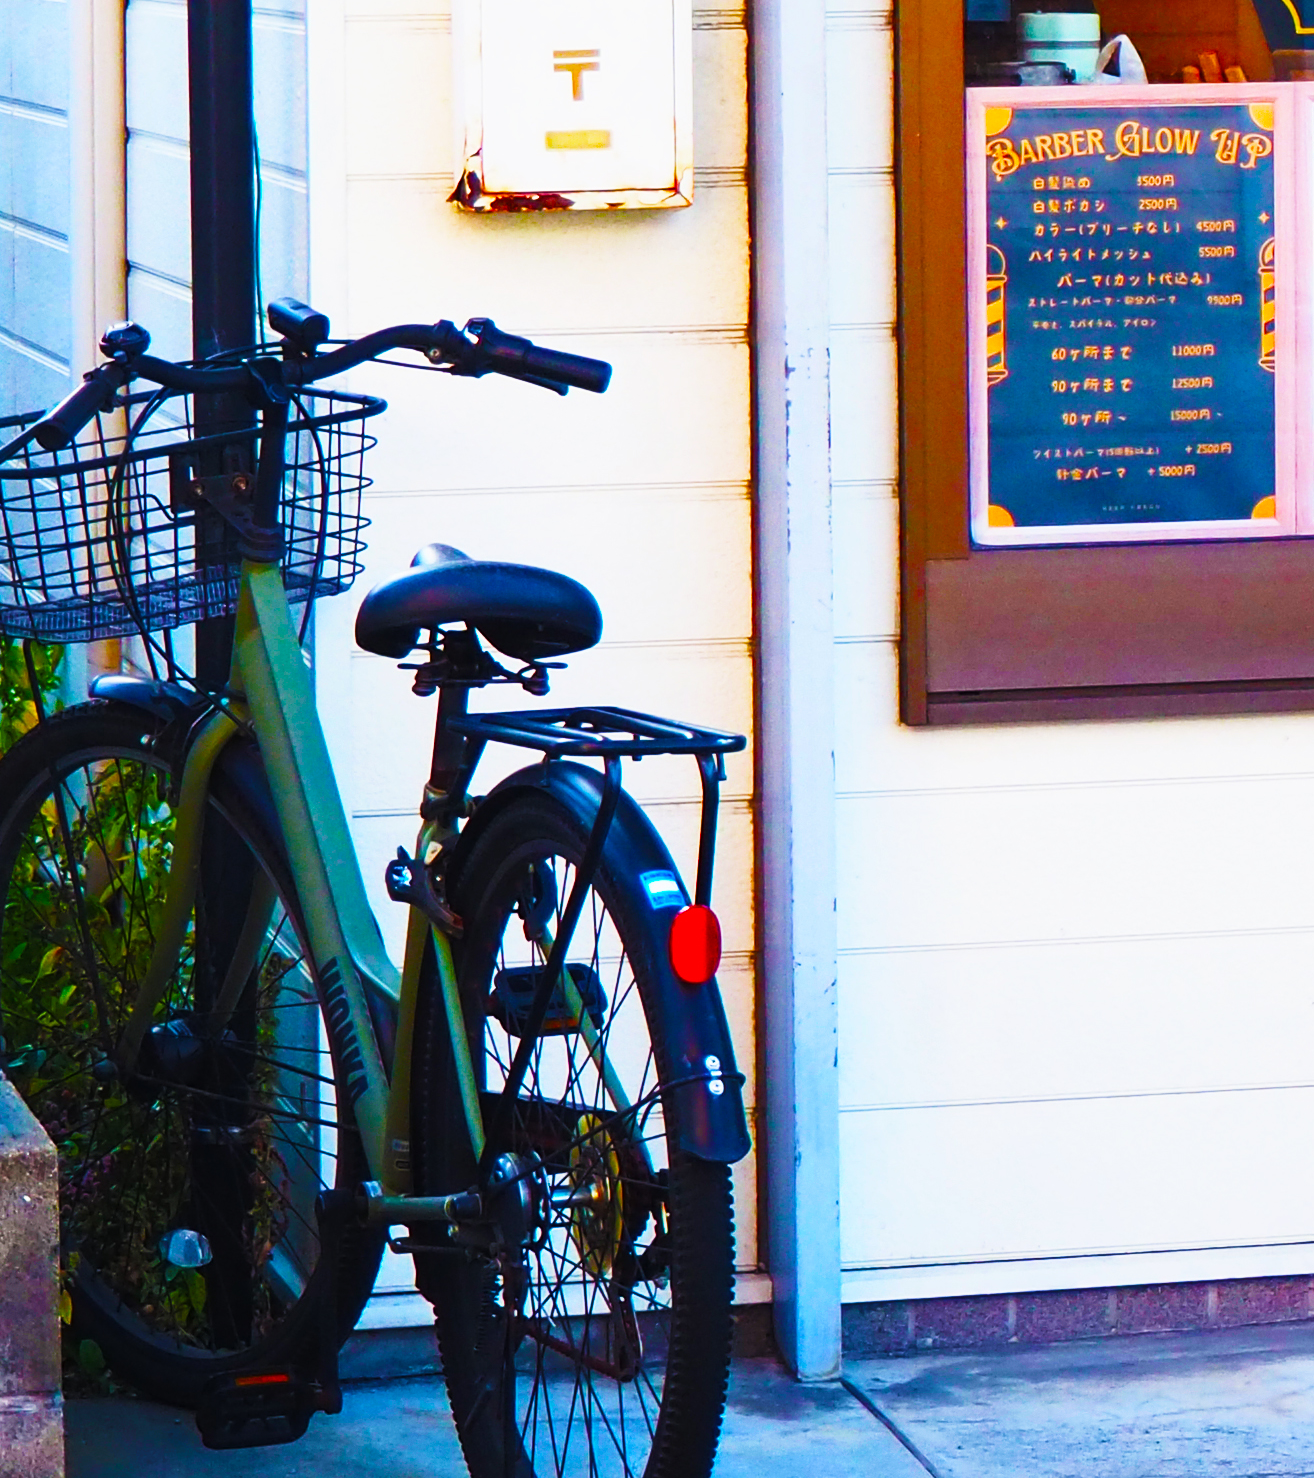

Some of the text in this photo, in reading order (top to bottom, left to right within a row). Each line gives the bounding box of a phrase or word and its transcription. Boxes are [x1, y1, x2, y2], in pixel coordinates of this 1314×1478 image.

[986, 121, 1272, 182] BARBER GLOW UP
[1139, 197, 1178, 211] 2500円
[1196, 220, 1236, 234] 4500円
[1028, 248, 1151, 262] ハイライトメッシュ
[1172, 344, 1215, 357] 11000円
[1172, 376, 1213, 390] 12500円
